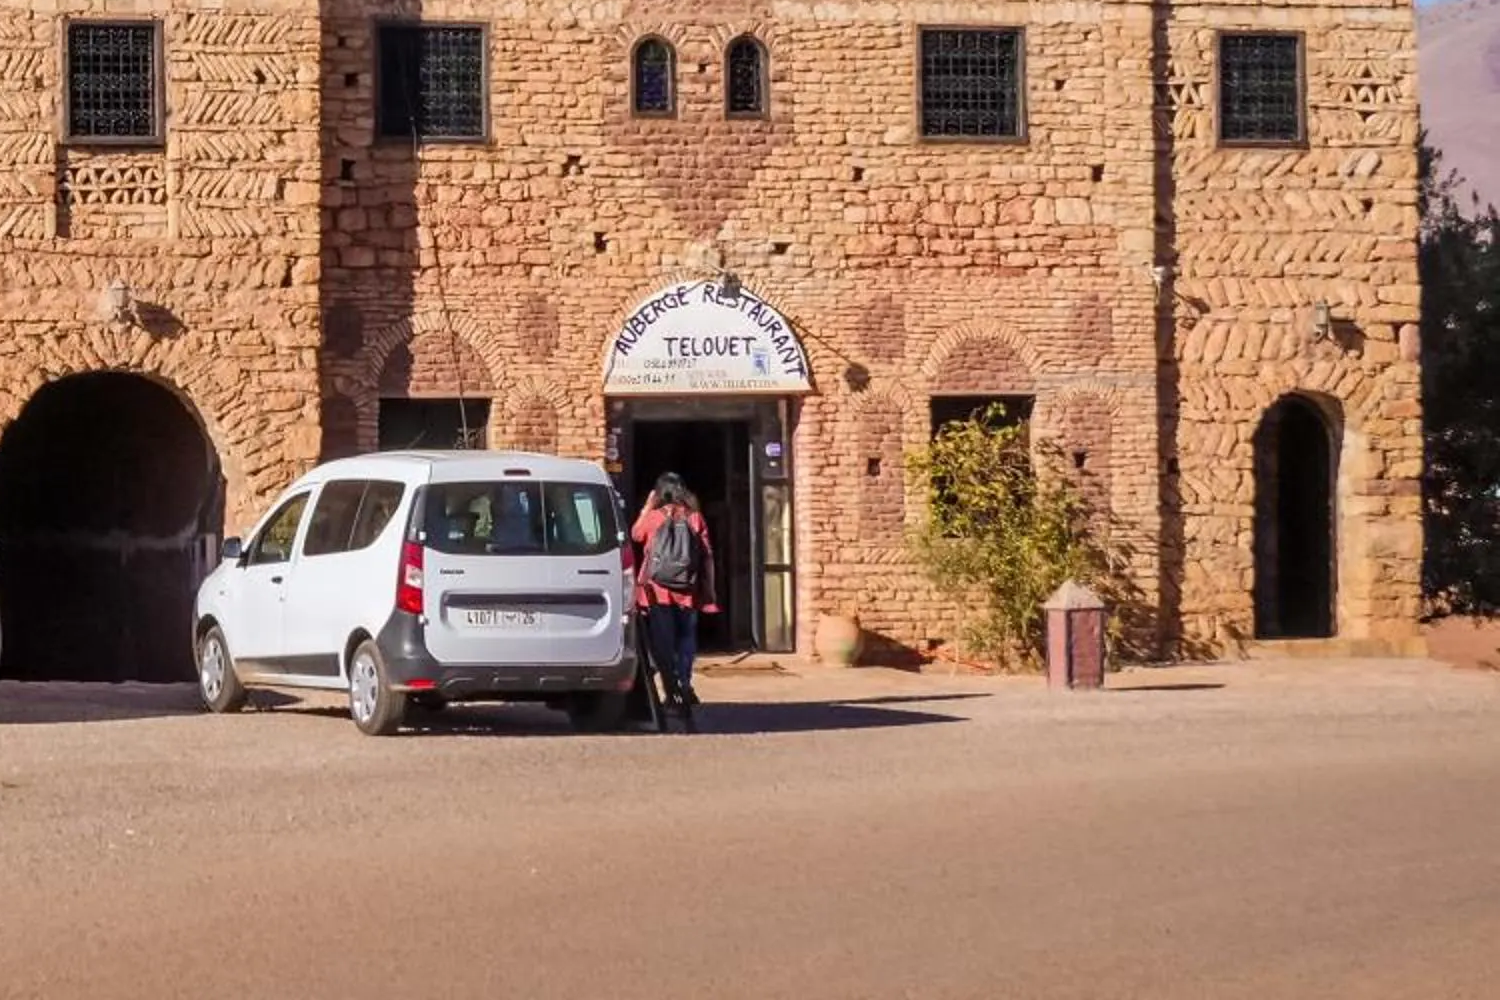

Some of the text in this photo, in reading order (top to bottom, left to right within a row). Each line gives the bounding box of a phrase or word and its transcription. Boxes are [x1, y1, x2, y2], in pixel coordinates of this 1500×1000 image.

[615, 284, 806, 376] AUBERGE RESTAURANT
[663, 336, 757, 357] TELOUET
